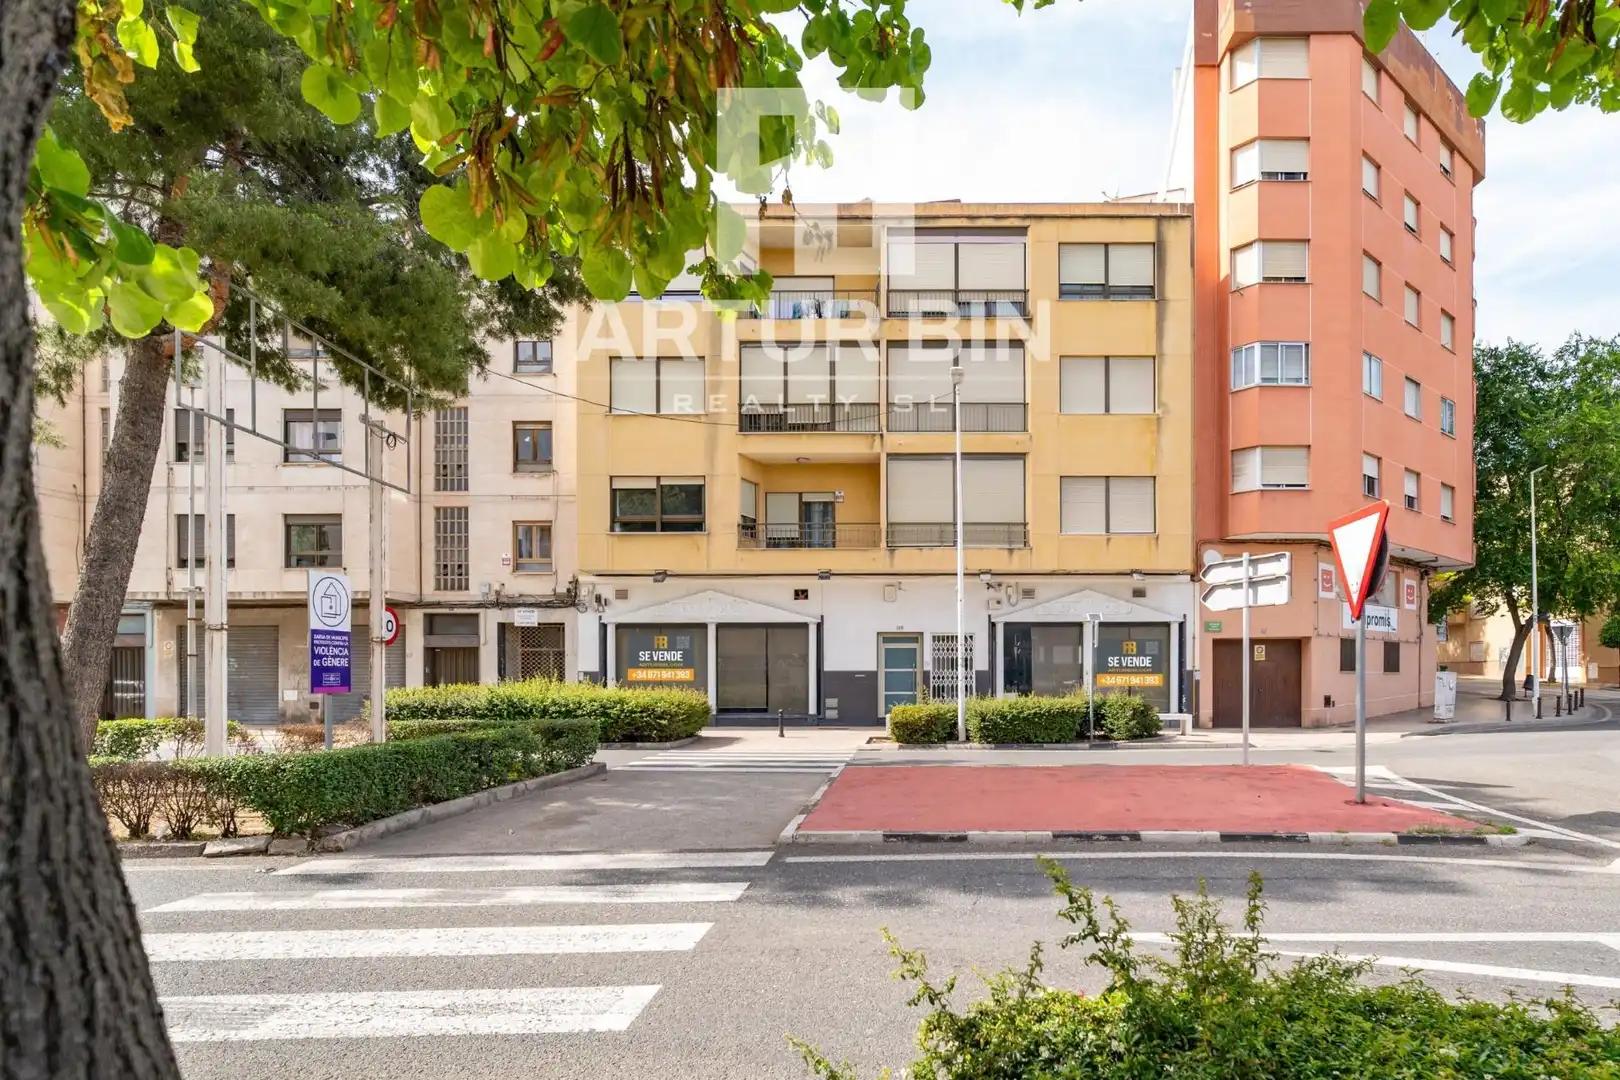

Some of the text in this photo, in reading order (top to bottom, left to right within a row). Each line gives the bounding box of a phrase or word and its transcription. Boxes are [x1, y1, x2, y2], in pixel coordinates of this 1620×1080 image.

[639, 651, 683, 661] SE VENDE
[1108, 656, 1152, 667] SE VENDE
[1101, 676, 1115, 685] +34
[1130, 676, 1143, 685] 941
